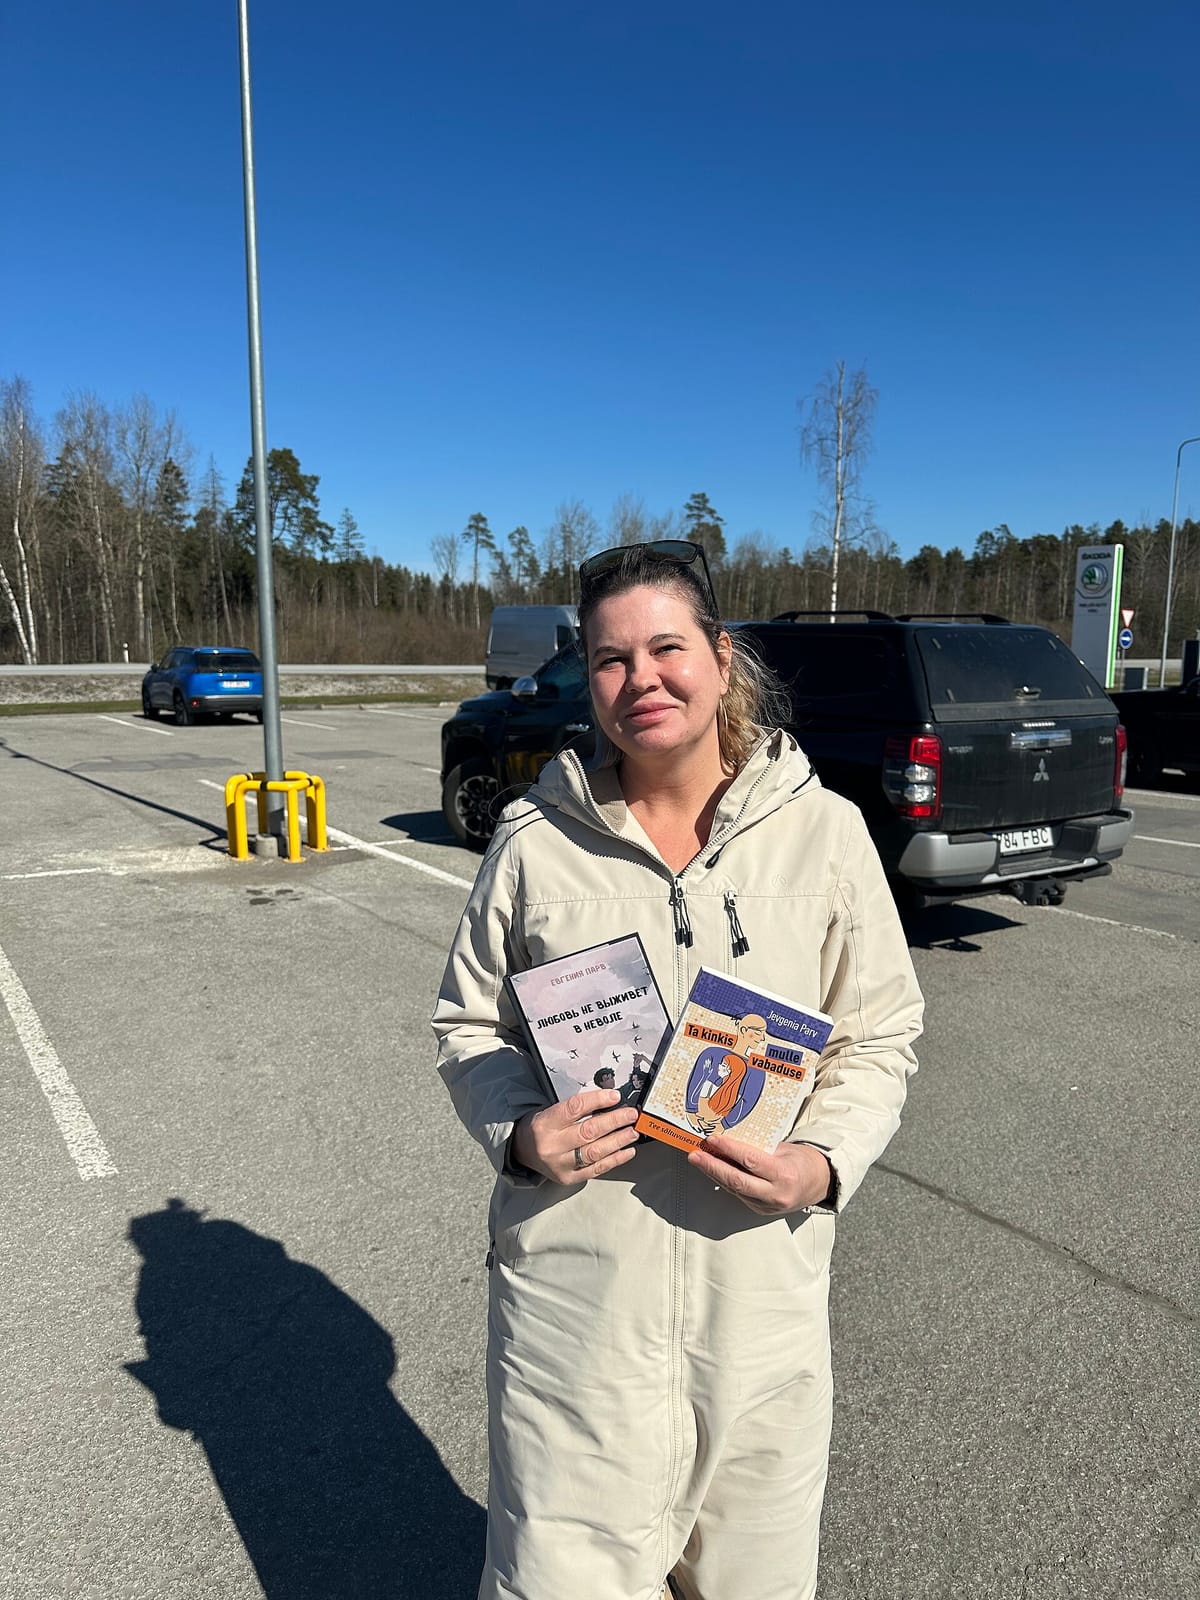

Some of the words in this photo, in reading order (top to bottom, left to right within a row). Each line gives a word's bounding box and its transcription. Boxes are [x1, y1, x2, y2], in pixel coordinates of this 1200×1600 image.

[1022, 827, 1049, 847] FBC
[551, 970, 585, 987] ЕВГЕНИЯ
[585, 963, 607, 977] ПАРВ
[537, 1010, 580, 1030] ЛЮБОВЬ
[581, 1003, 594, 1016] НЕ
[596, 986, 649, 1010] ВЫЖИВЕТ
[573, 1025, 583, 1034] В
[584, 1011, 624, 1031] НЕВОЛЕ
[767, 1010, 799, 1033] Jevgenia
[799, 1022, 818, 1038] Parv
[687, 1024, 699, 1038] Ta
[700, 1027, 734, 1047] kinkis
[751, 1056, 803, 1080] vabaduse
[768, 1048, 800, 1064] mulle
[648, 1121, 661, 1131] Tee
[661, 1127, 696, 1146] sõltuvusest
